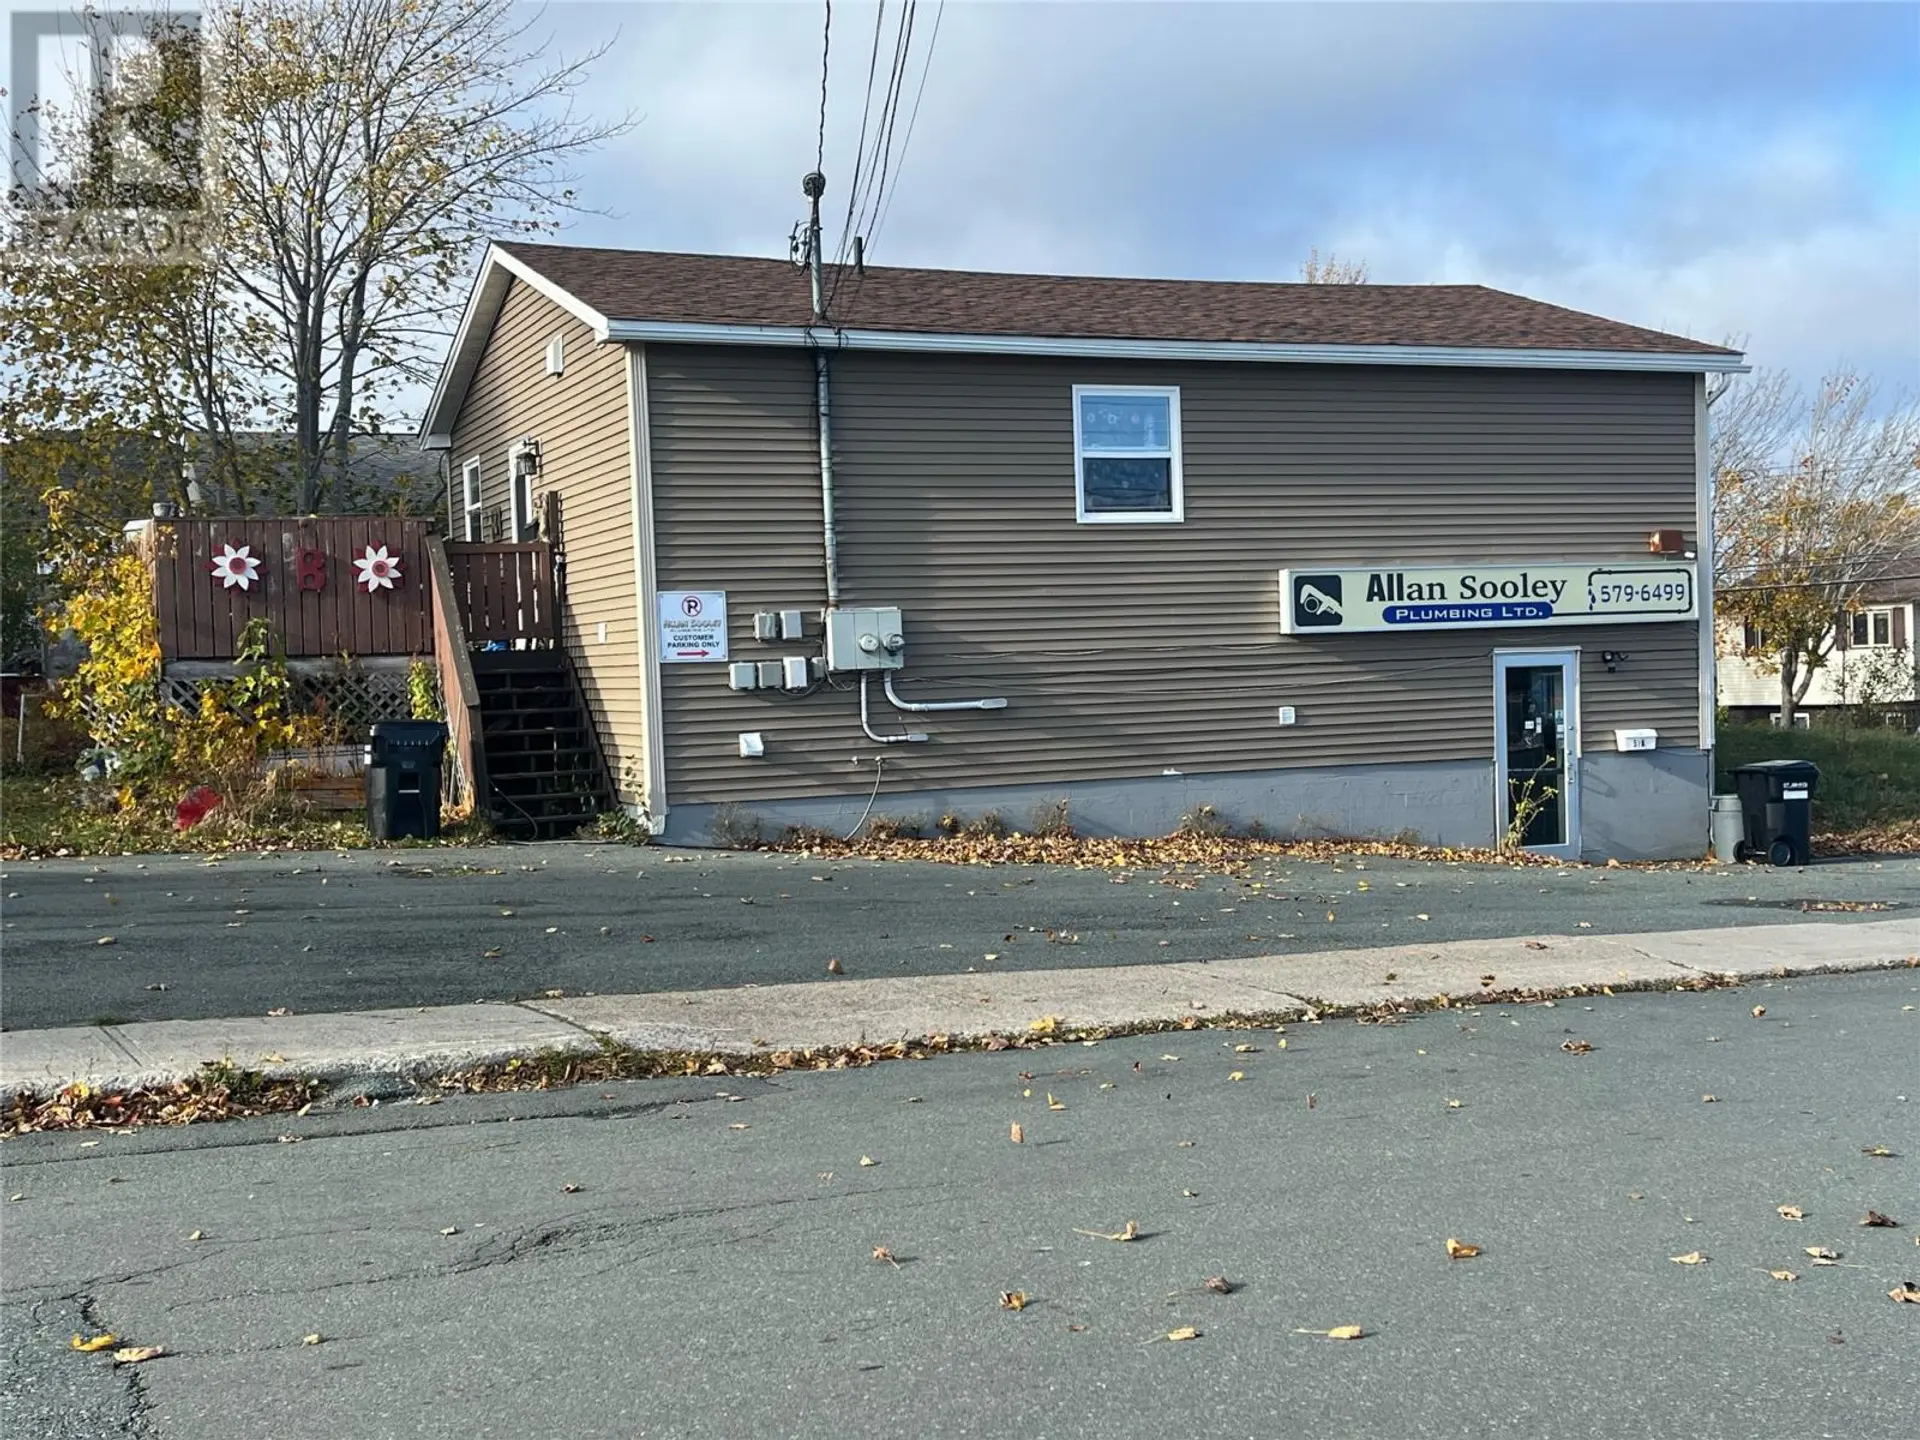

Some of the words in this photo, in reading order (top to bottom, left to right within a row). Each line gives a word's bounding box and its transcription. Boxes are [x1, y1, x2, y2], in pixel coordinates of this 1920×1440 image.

[1366, 573, 1448, 602] Allan
[1460, 572, 1568, 604] Sooley
[1600, 583, 1685, 603] 579-6499
[1395, 608, 1493, 620] PLUMBING
[1502, 606, 1543, 617] LTD.
[667, 641, 700, 649] PARKING
